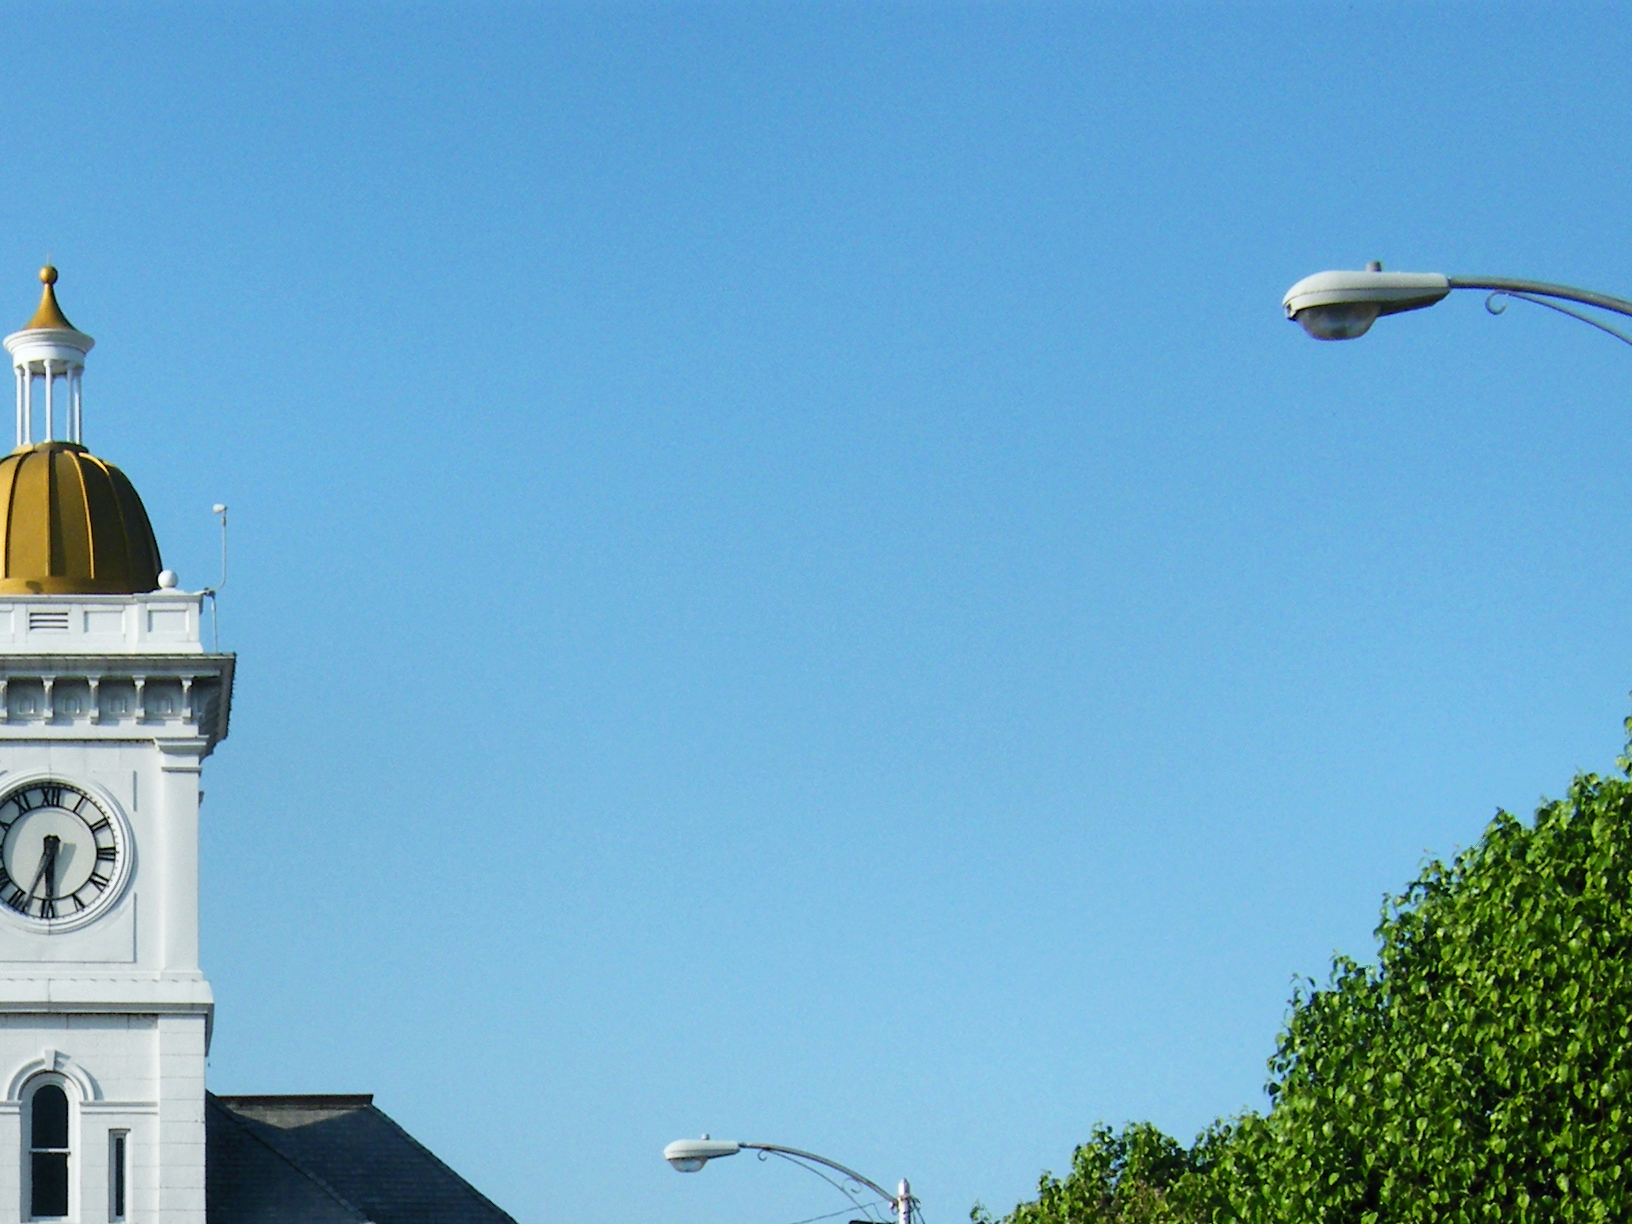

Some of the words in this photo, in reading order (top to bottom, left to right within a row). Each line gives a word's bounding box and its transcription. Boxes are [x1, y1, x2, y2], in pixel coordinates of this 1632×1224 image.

[89, 817, 110, 834] II
[97, 847, 116, 861] III
[40, 898, 56, 919] VI
[71, 893, 87, 913] V
